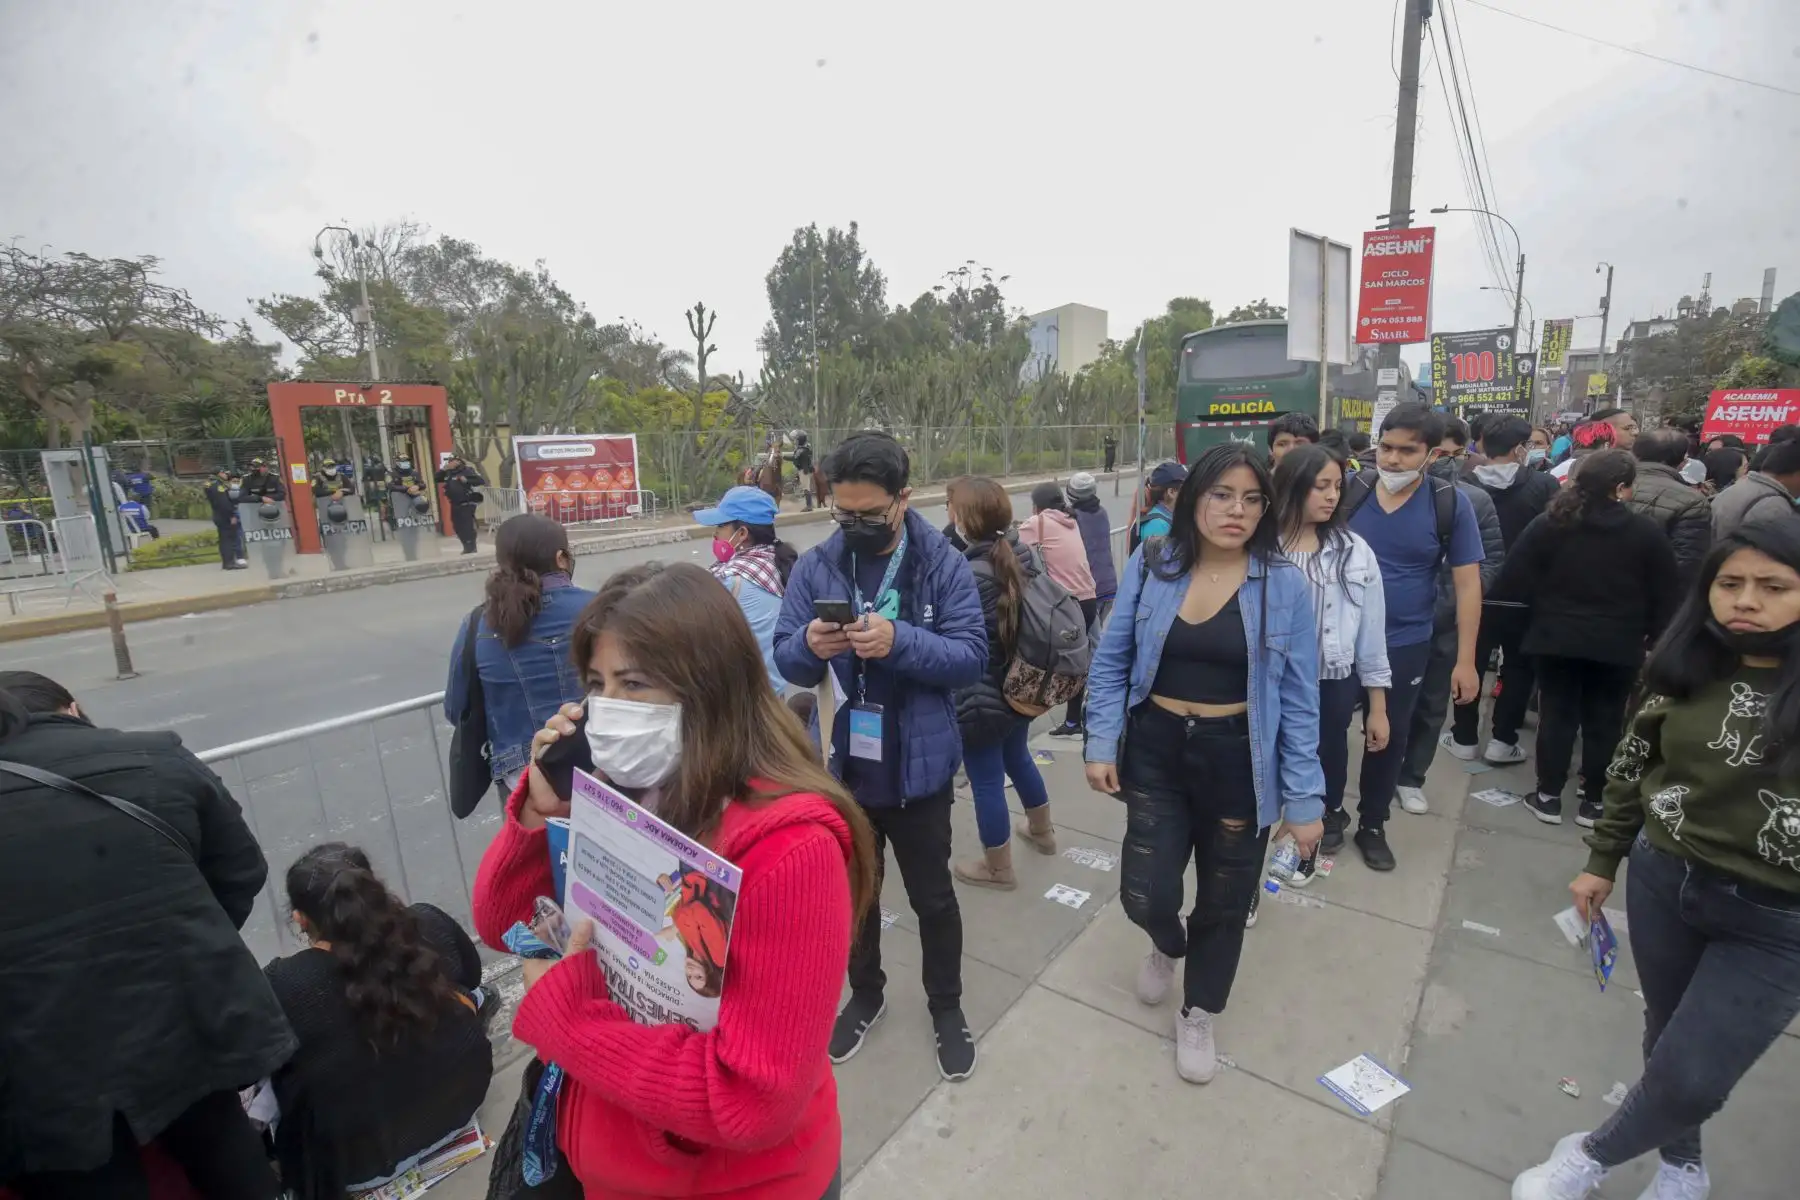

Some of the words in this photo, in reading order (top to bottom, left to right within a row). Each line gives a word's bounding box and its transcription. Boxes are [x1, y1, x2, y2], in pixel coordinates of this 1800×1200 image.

[1382, 270, 1409, 278] CICLO
[1365, 281, 1384, 289] SAN
[1386, 279, 1425, 287] MARCOS
[1370, 328, 1410, 340] SMARK
[1433, 336, 1443, 405] ACADEMIA
[1452, 351, 1495, 382] 100
[380, 389, 393, 404] 2
[1458, 394, 1474, 403] 966
[1495, 392, 1512, 400] 421
[1209, 400, 1276, 415] POLICÍA
[245, 528, 292, 542] POLICIA
[660, 830, 698, 858] ACADEMIA
[655, 976, 680, 997] CLASES
